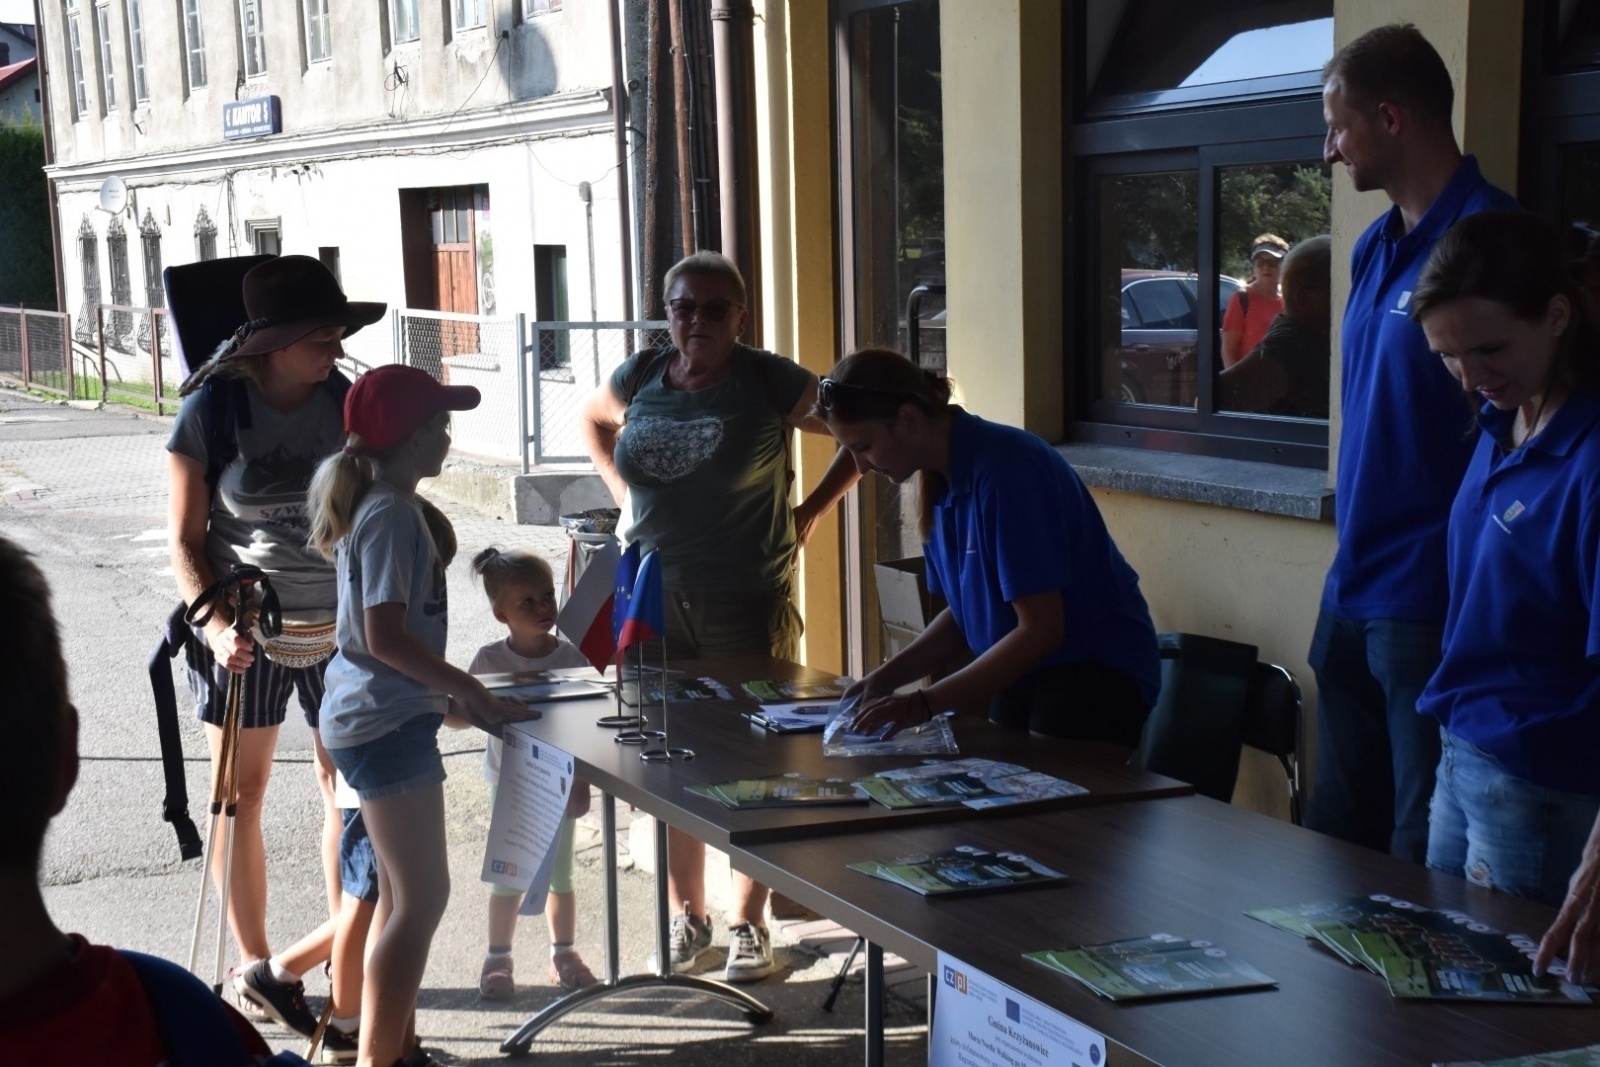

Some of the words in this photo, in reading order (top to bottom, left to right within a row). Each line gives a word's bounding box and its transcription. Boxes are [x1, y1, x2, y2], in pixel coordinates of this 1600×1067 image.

[232, 103, 261, 126] KANTOR
[988, 1015, 1008, 1034] Gmina
[1008, 1027, 1049, 1057] Krzyżanowice
